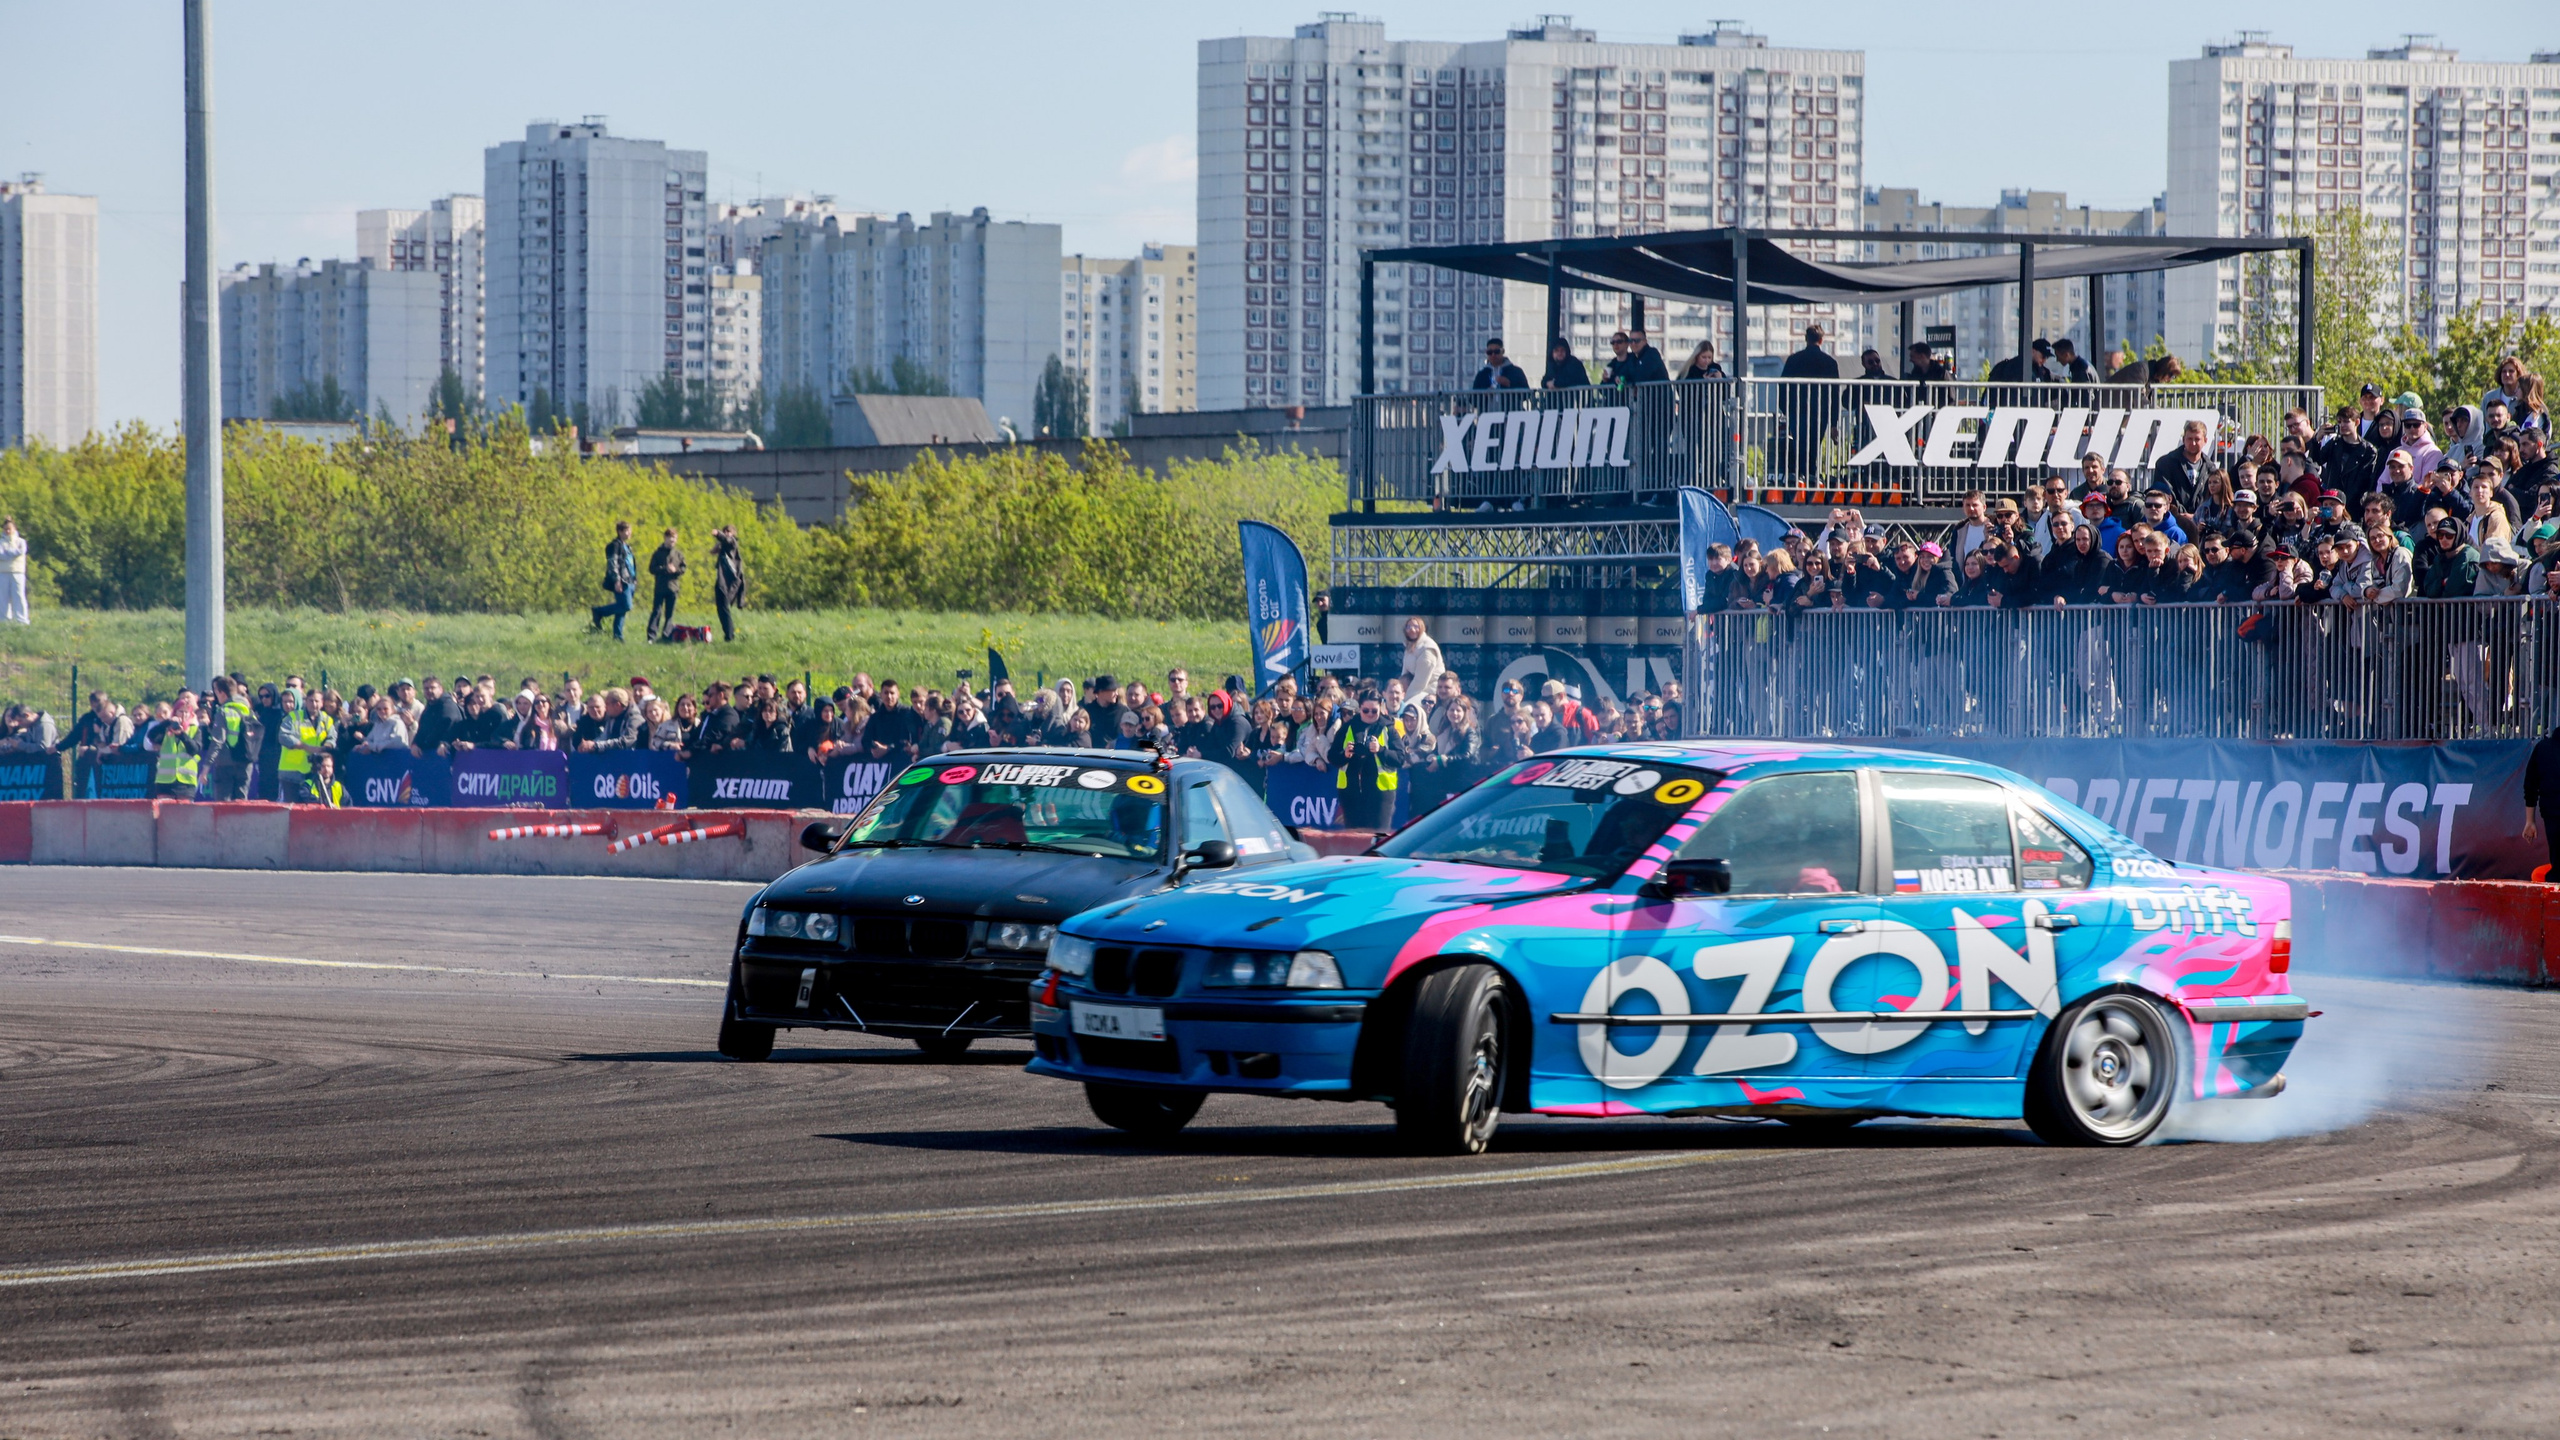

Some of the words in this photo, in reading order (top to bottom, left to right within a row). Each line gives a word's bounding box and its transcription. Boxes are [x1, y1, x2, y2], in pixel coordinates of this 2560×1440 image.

[1430, 406, 1631, 474] XENUM
[1847, 404, 2220, 469] XENUM
[1508, 627, 1529, 636] GNV
[1556, 627, 1577, 636] GNV
[1314, 654, 1336, 664] GNV
[101, 765, 148, 785] TSUNAMI
[629, 772, 661, 799] Oils
[365, 778, 400, 803] GNV
[712, 777, 790, 800] XENUM
[1290, 796, 1337, 826] GNV
[2111, 858, 2178, 878] OZON
[1183, 882, 1326, 904] OZON
[2124, 884, 2257, 937] Drift
[1577, 899, 2061, 1090] OZON
